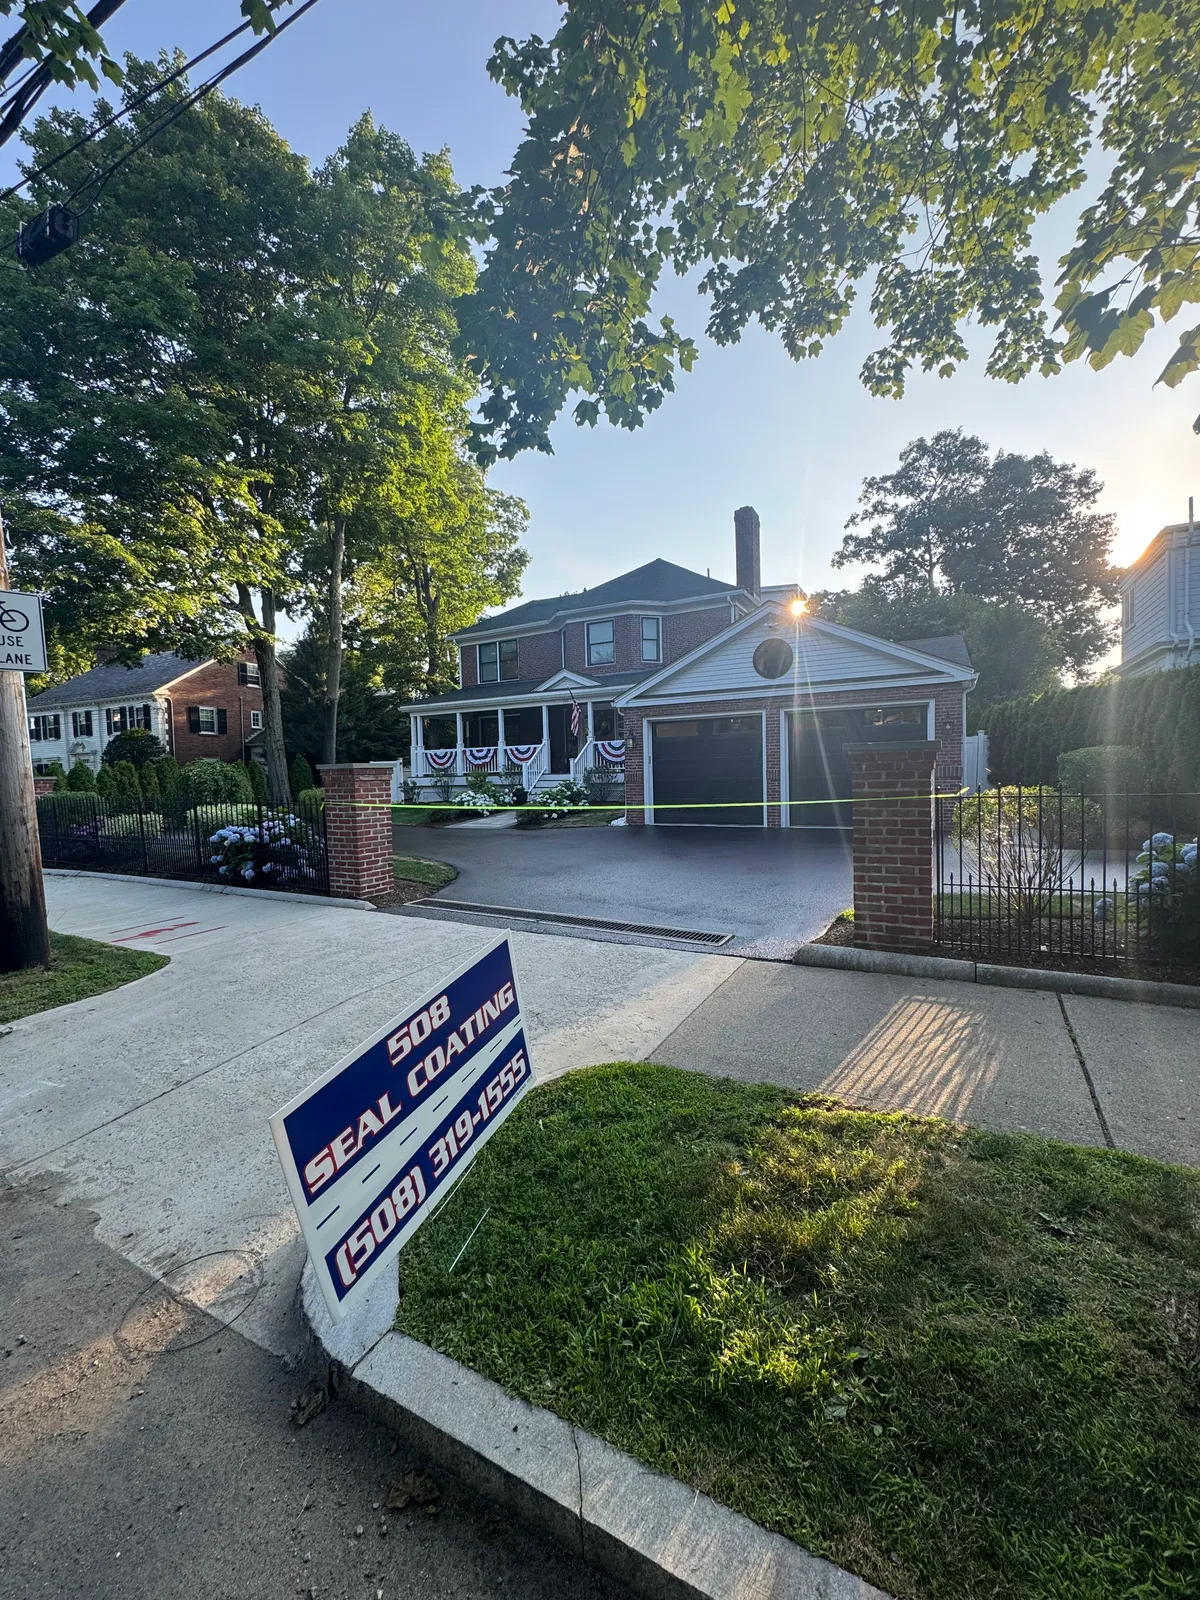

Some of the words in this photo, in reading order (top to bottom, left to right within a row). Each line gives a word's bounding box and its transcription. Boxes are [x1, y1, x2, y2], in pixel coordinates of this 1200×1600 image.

[304, 1090, 402, 1195] SEAL
[407, 981, 515, 1097] COATING
[387, 994, 451, 1066] 508
[336, 1165, 427, 1287] (508)
[428, 1048, 527, 1180] 319-1555
